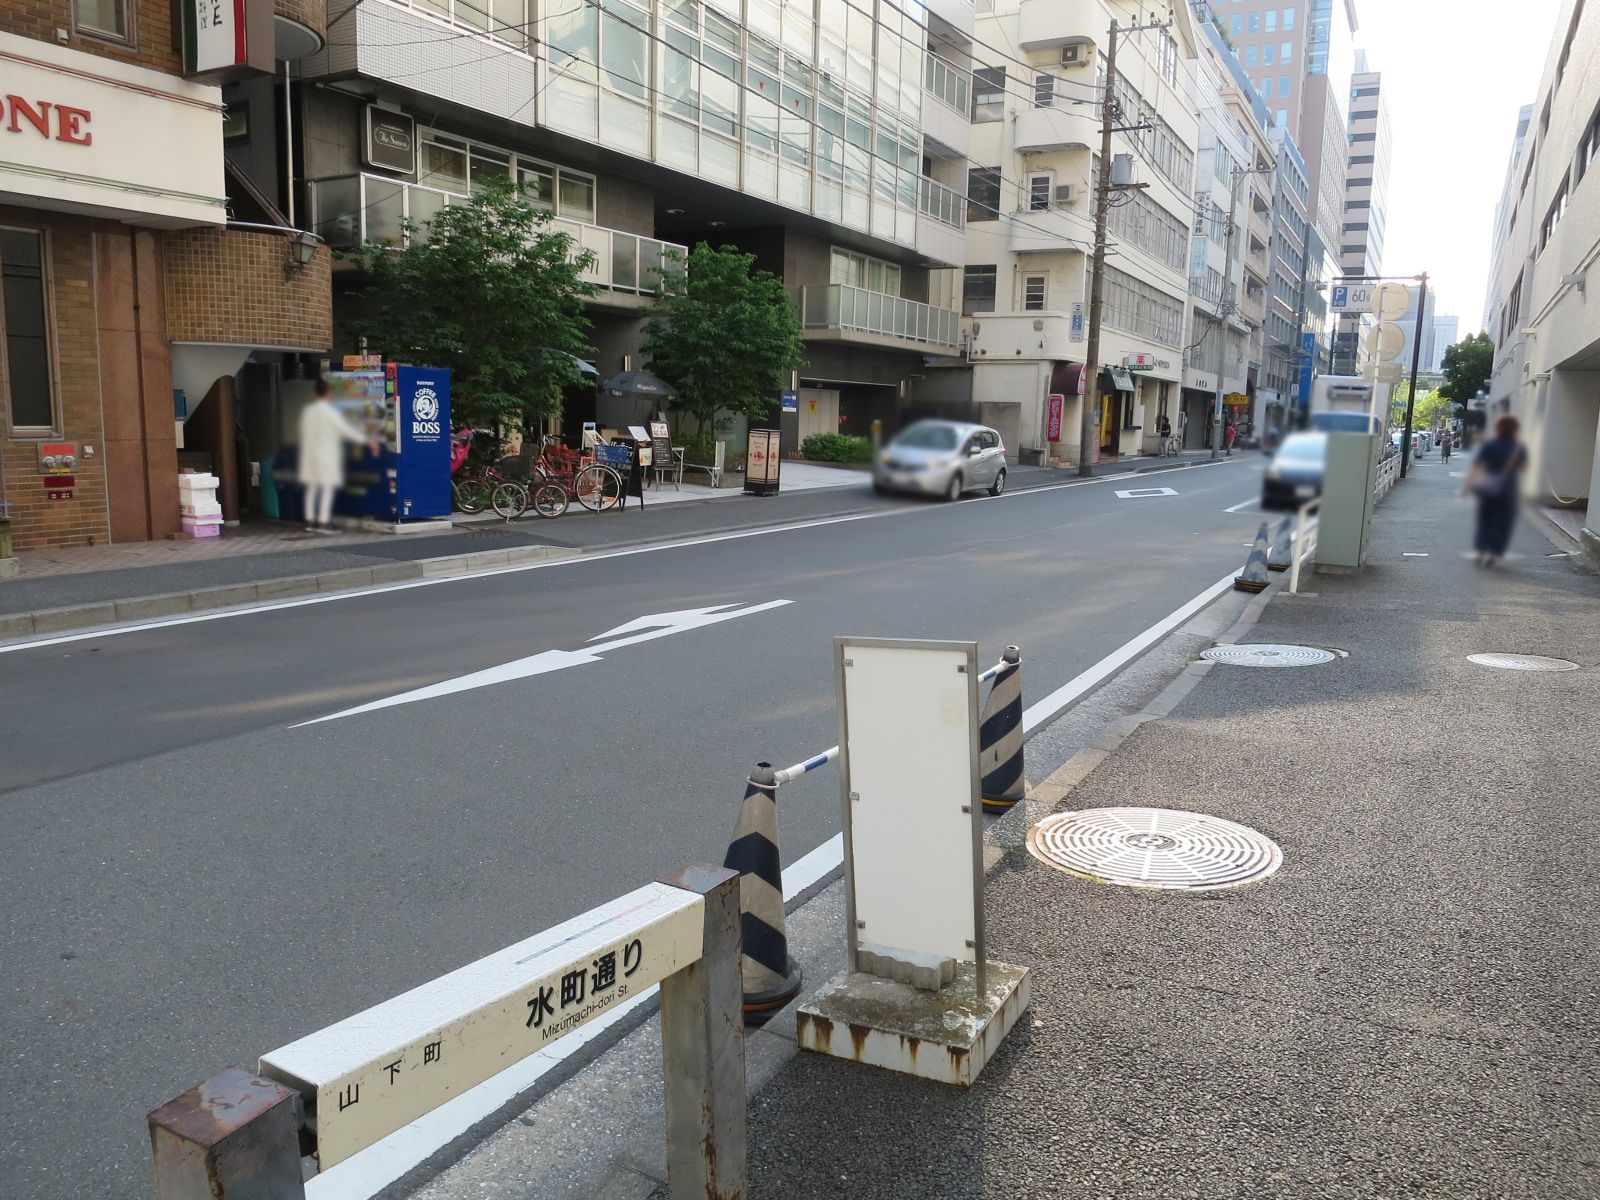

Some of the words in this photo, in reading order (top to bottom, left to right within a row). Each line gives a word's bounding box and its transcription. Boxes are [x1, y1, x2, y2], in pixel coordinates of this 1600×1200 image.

[1335, 288, 1344, 300] P
[1135, 355, 1146, 365] 薬
[414, 387, 437, 399] COFFEE
[412, 421, 441, 434] BOSS
[525, 938, 642, 1028] 水町通り
[542, 990, 615, 1041] Mizumachi-dori
